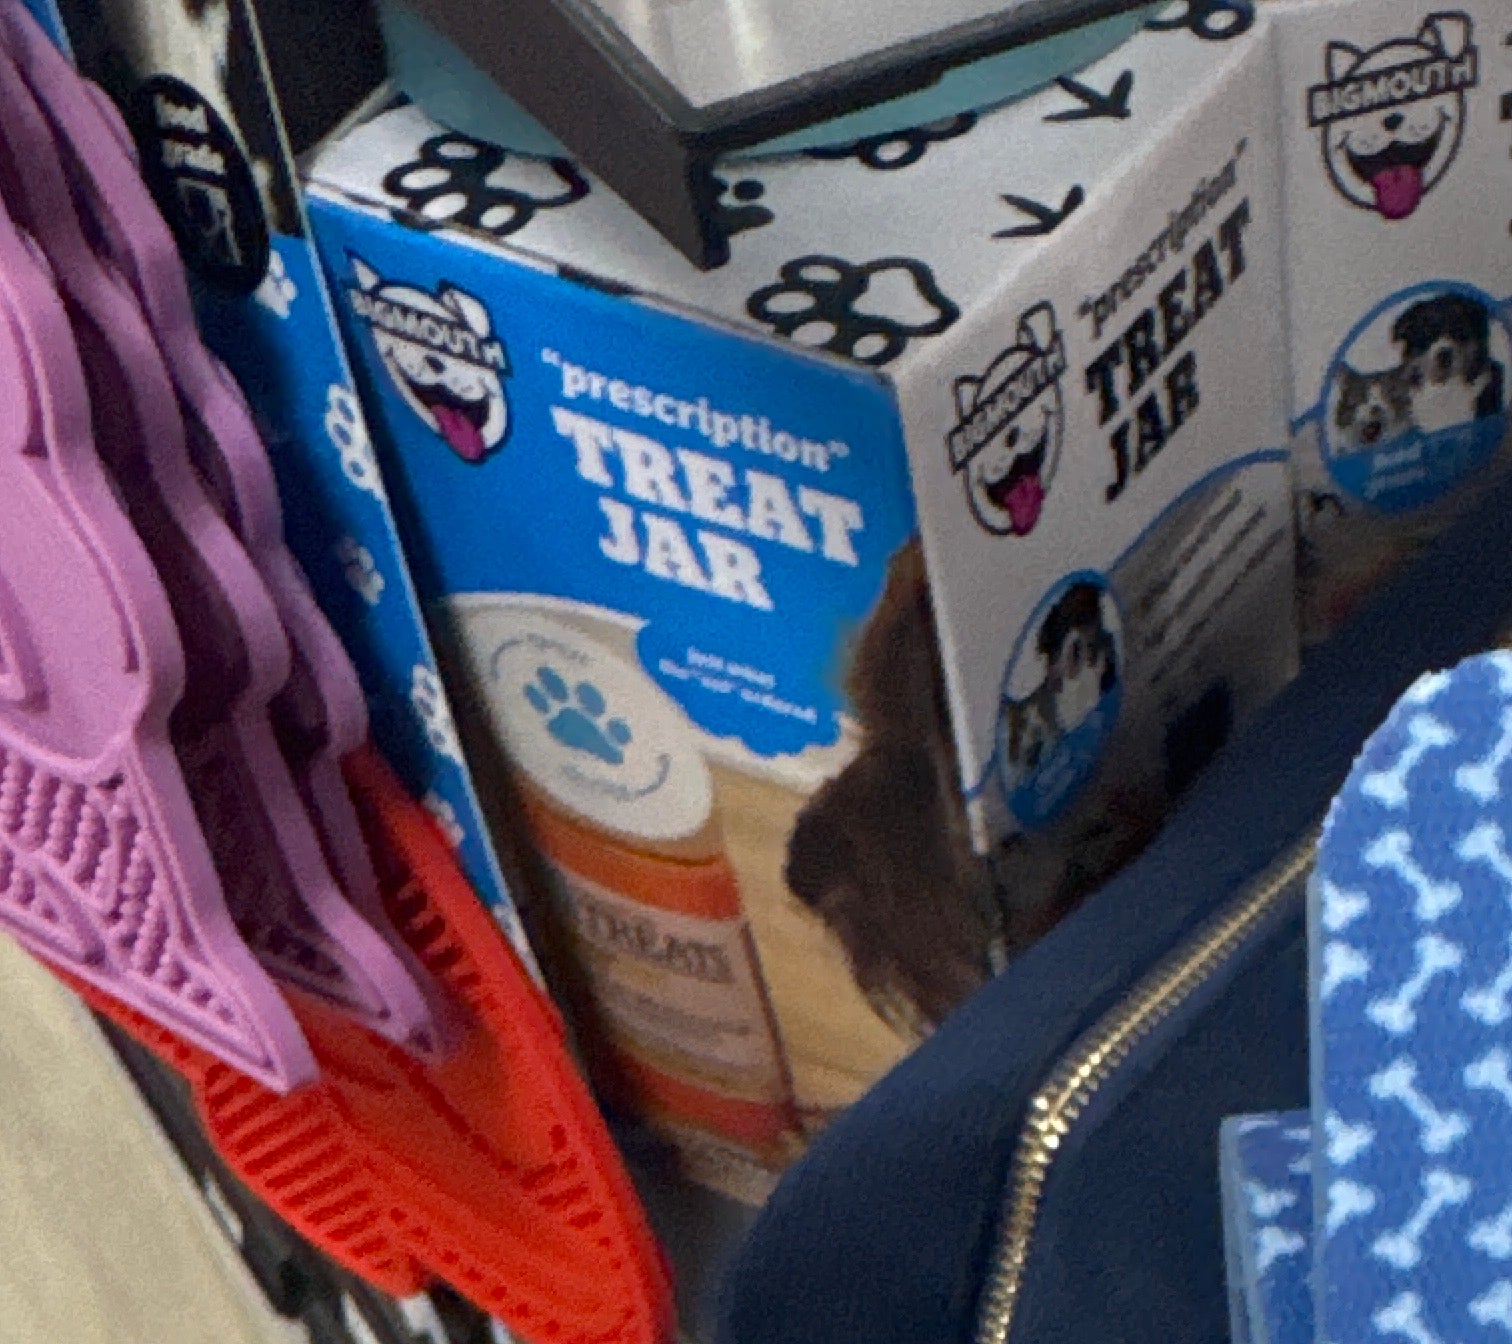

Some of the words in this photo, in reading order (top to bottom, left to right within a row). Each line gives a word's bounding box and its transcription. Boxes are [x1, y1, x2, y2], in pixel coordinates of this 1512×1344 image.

[1312, 56, 1472, 122] BIGMOUTH
[348, 287, 508, 373] BIGMOUTH
[1085, 198, 1252, 429] TREAT
[549, 406, 865, 567] TREAT
[1105, 350, 1200, 504] JAR
[599, 497, 775, 612] JAR
